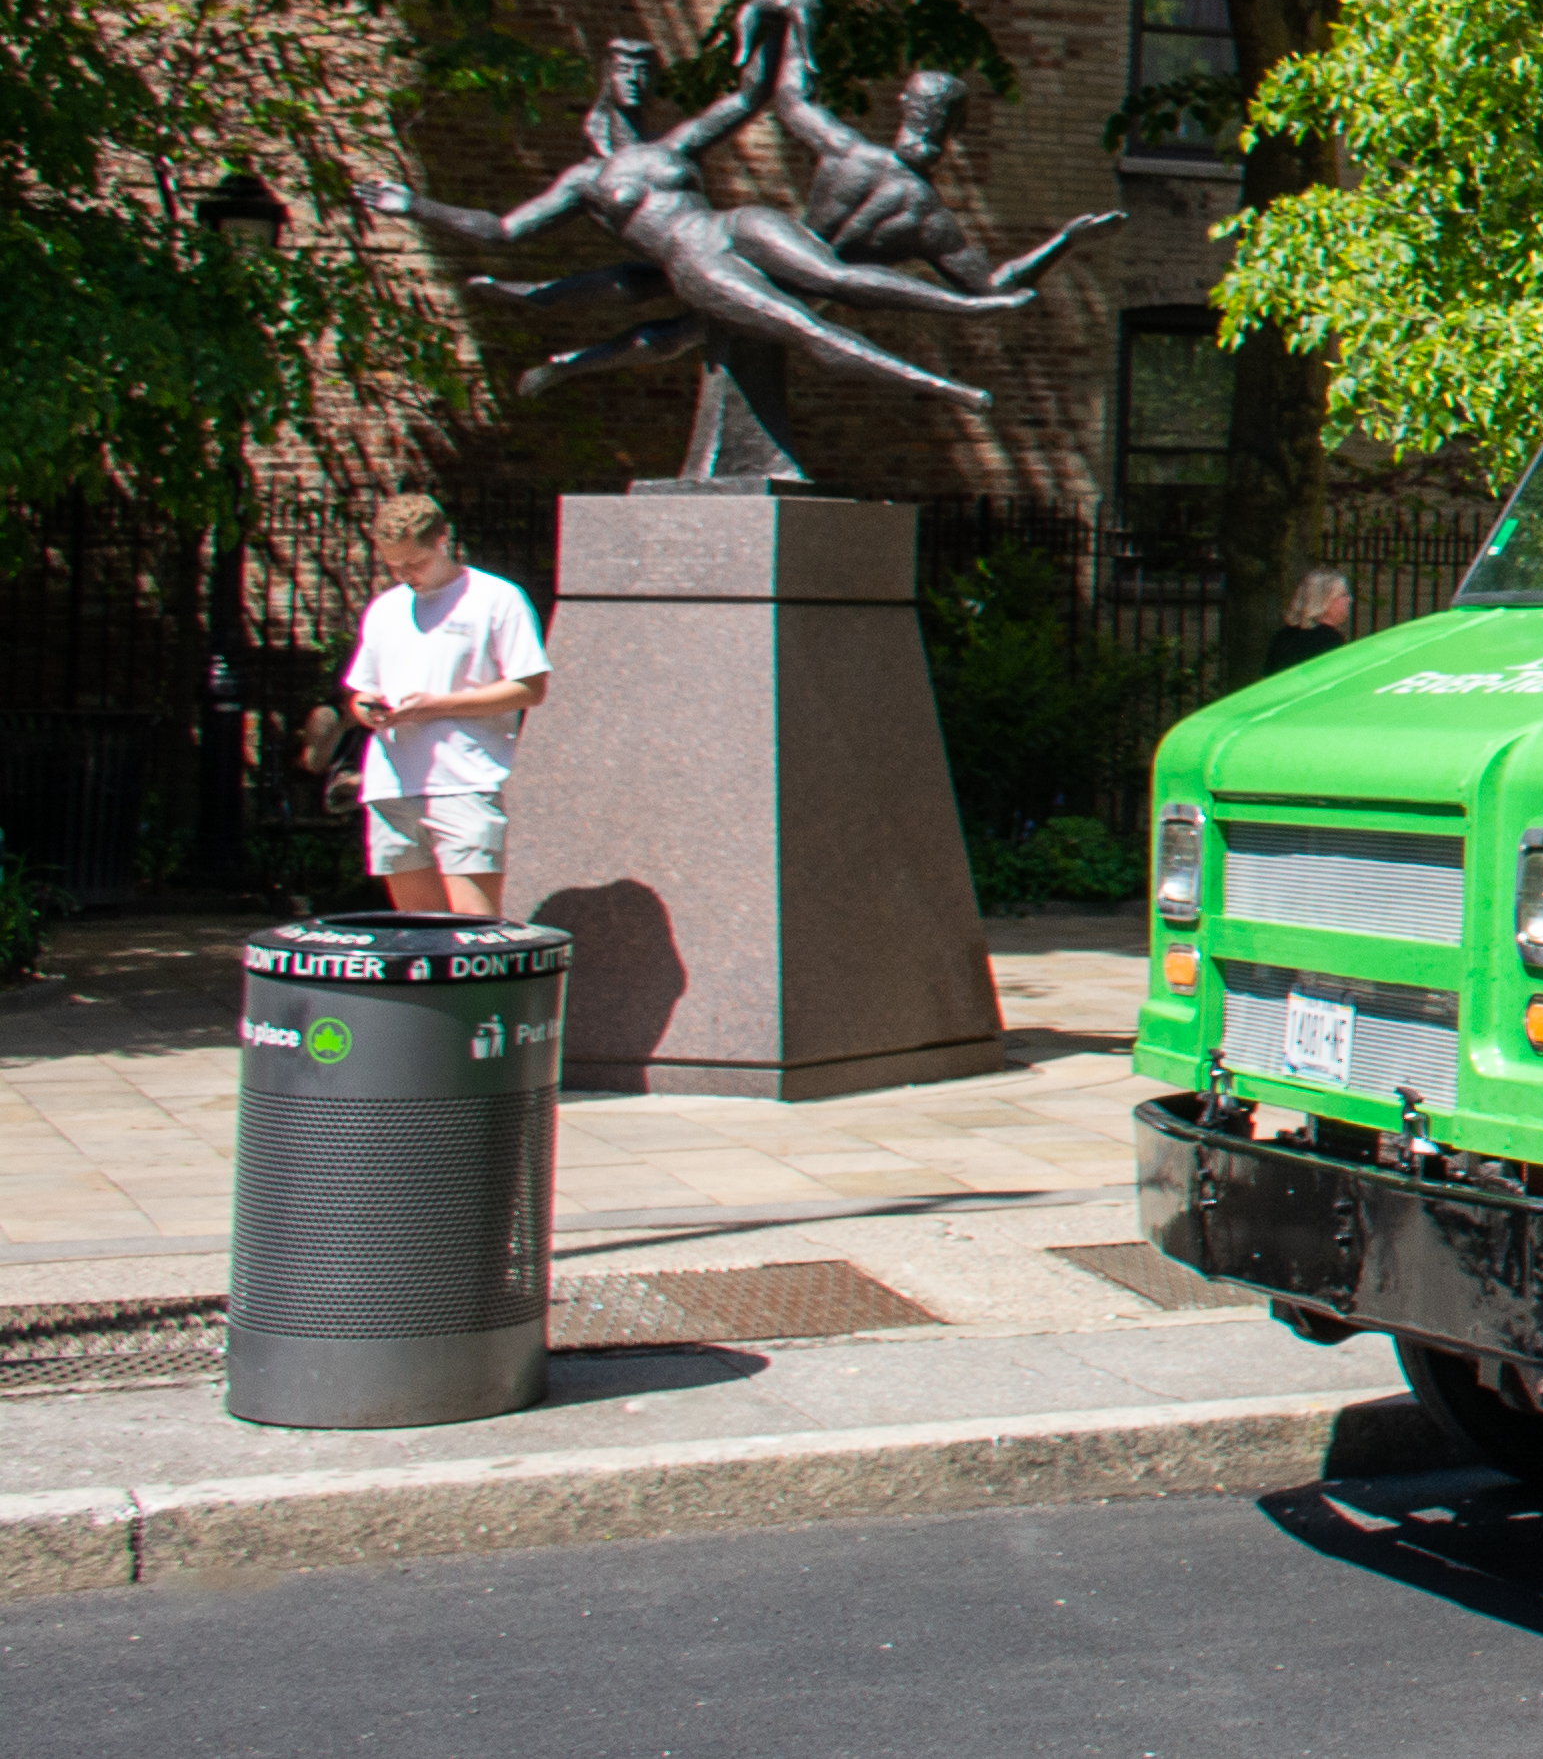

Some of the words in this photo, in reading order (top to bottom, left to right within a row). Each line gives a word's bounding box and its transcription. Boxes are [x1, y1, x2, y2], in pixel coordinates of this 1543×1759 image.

[291, 951, 387, 981] LITTER
[447, 952, 525, 980] DON'T
[251, 1020, 303, 1049] place
[514, 1022, 546, 1046] Put
